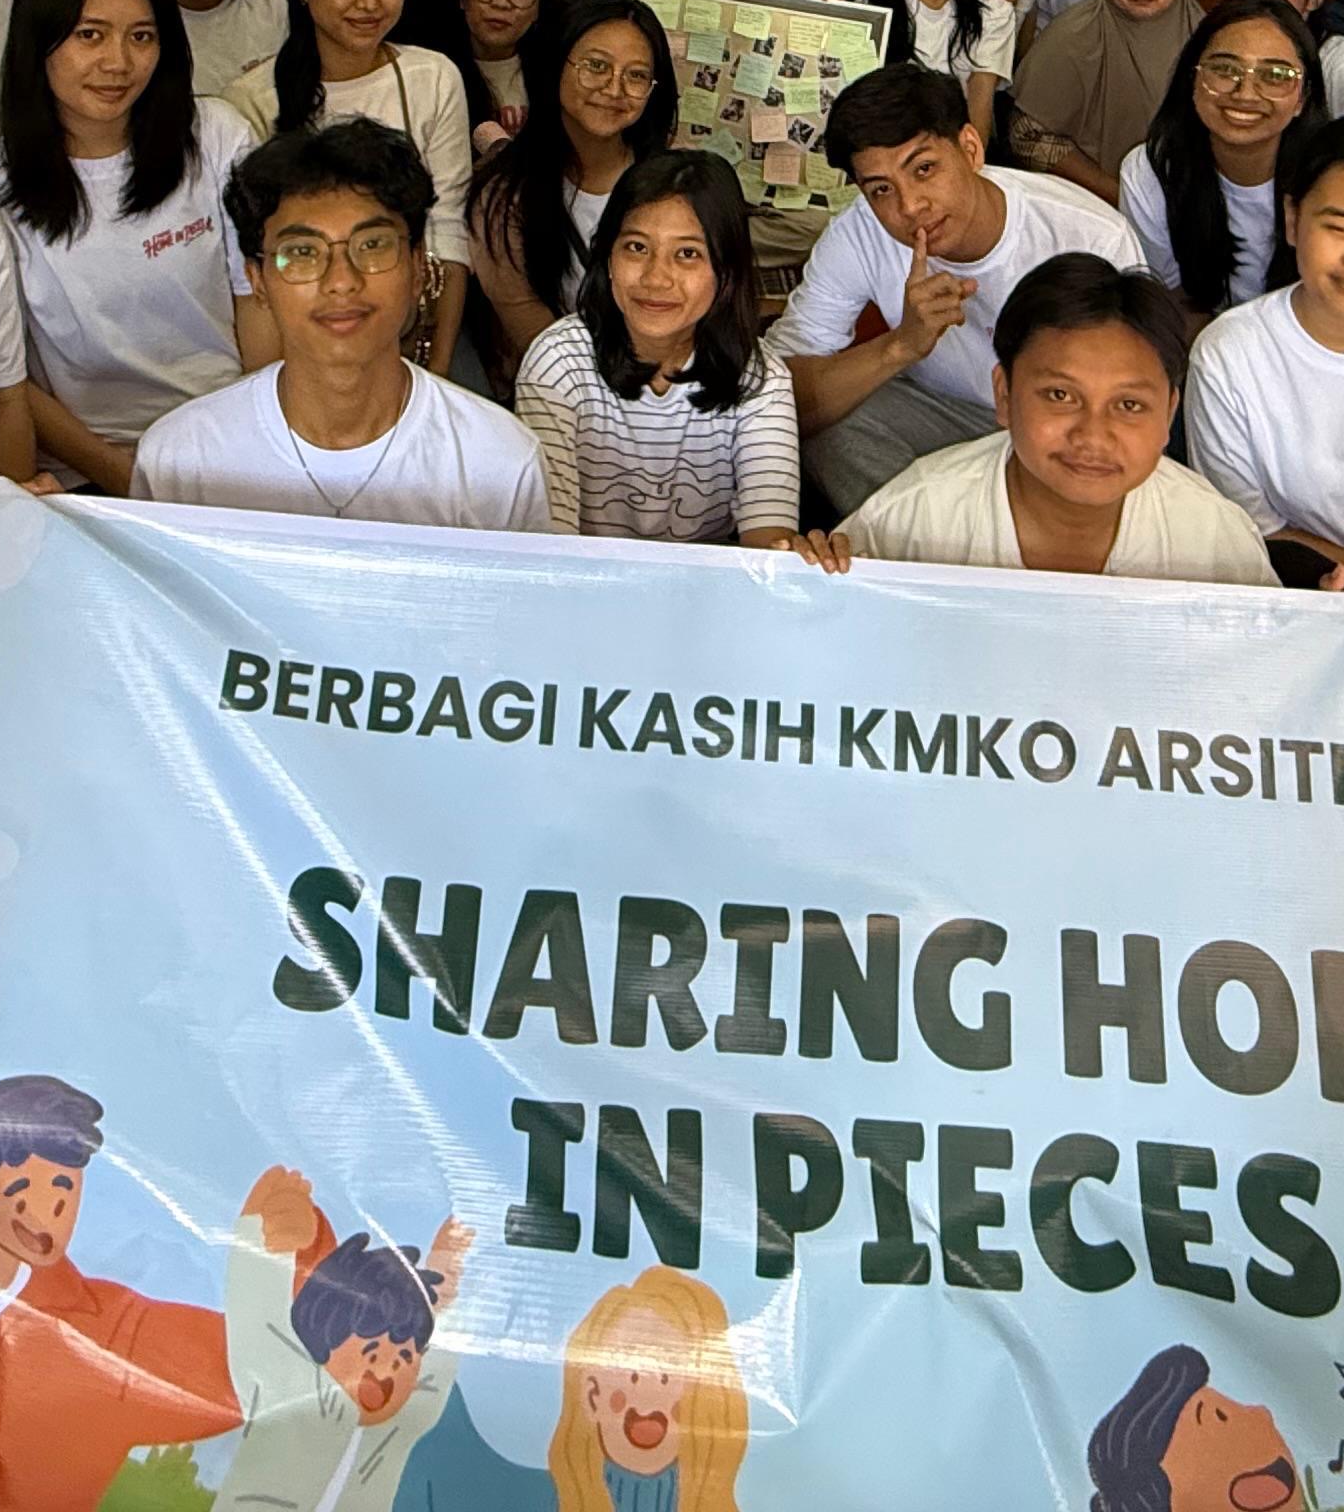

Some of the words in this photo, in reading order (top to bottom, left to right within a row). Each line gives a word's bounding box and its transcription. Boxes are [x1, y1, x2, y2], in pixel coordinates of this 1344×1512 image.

[216, 647, 560, 750] BERBAGI
[576, 684, 820, 767] KASIH
[837, 704, 1080, 786] KMKO
[270, 865, 1015, 1074] SHARING
[503, 1097, 705, 1273] IN
[752, 1111, 1344, 1322] PIECES
